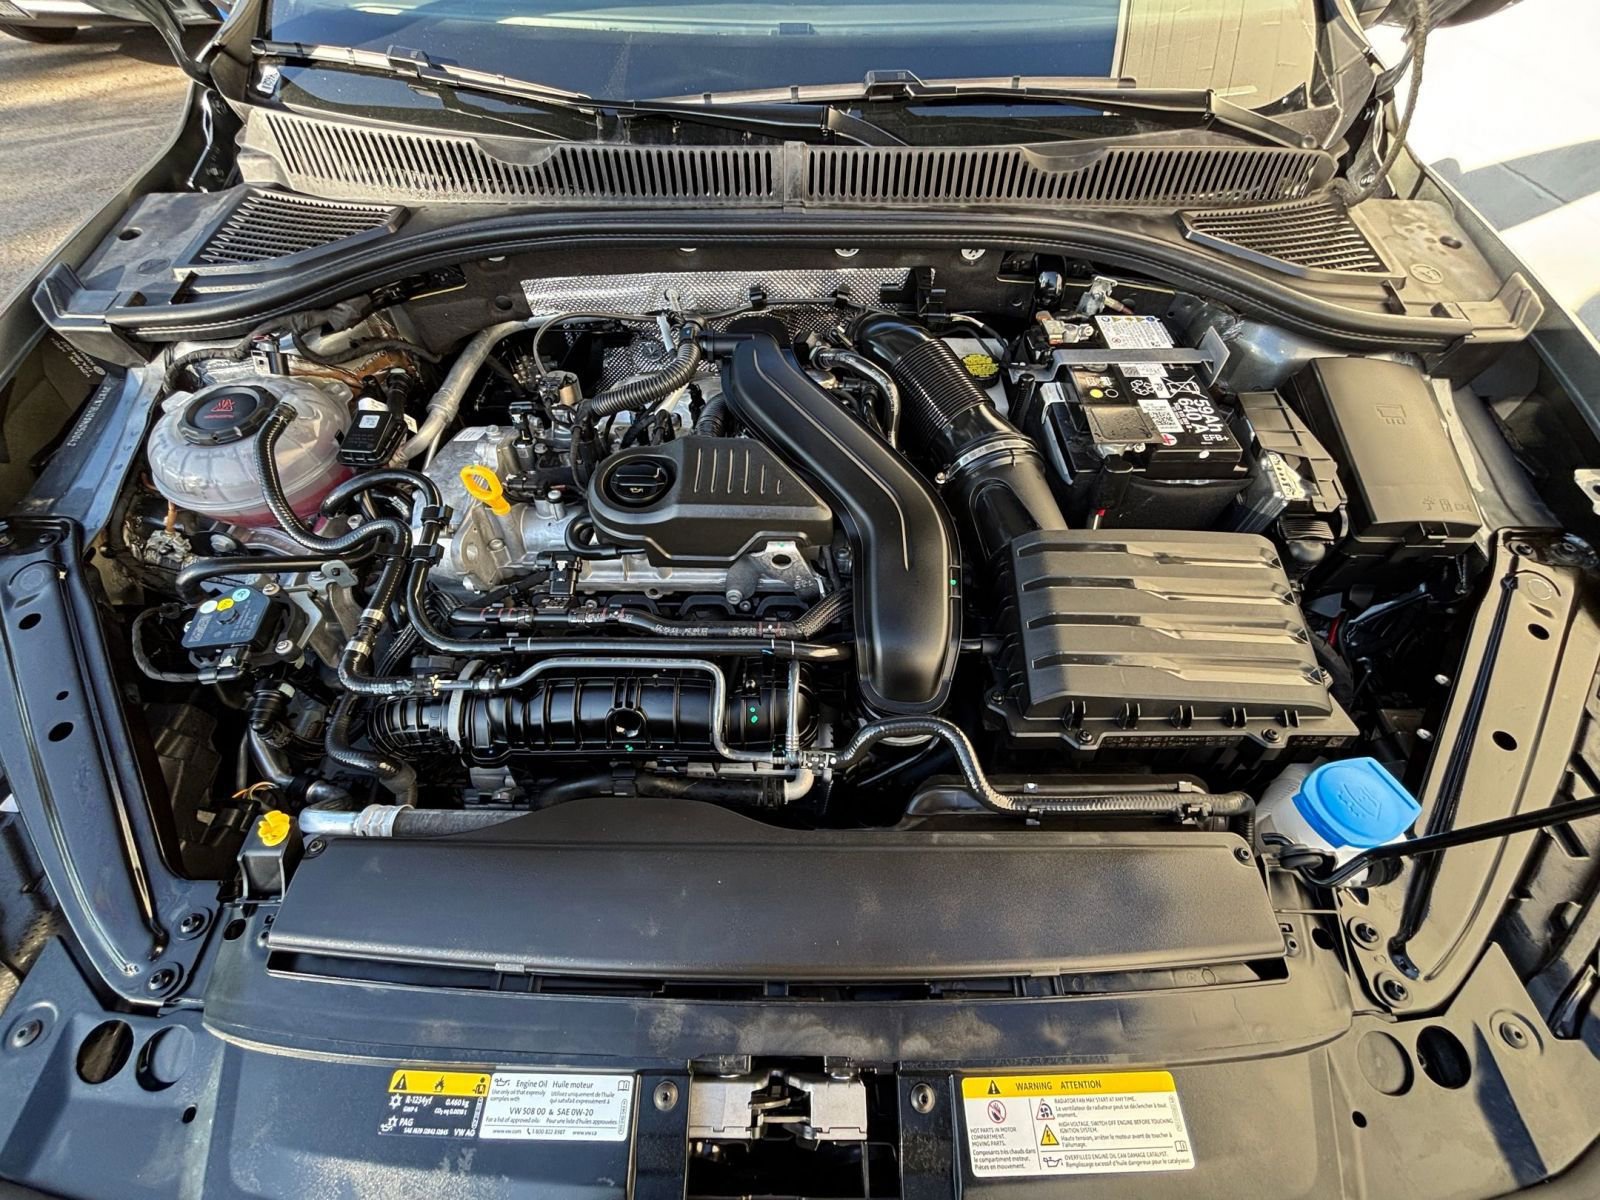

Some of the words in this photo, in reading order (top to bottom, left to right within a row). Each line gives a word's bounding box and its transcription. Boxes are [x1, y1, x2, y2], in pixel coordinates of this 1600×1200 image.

[1178, 398, 1202, 421] 640
[1191, 423, 1209, 434] A
[1194, 399, 1224, 432] 59Ah
[516, 1080, 537, 1089] Engine
[538, 1080, 548, 1088] Oil
[552, 1080, 569, 1088] Huile
[1015, 1081, 1052, 1091] WARNING
[1060, 1080, 1101, 1089] ATTENTION
[405, 1095, 433, 1107] R-1234yf
[461, 1099, 469, 1108] kg
[509, 1107, 521, 1115] VW
[523, 1107, 535, 1115] 508
[537, 1107, 546, 1115] 00
[557, 1108, 570, 1116] SAE
[571, 1108, 594, 1116] 0W-20
[399, 1118, 414, 1127] PAG
[454, 1128, 465, 1136] VW
[465, 1129, 475, 1137] AG
